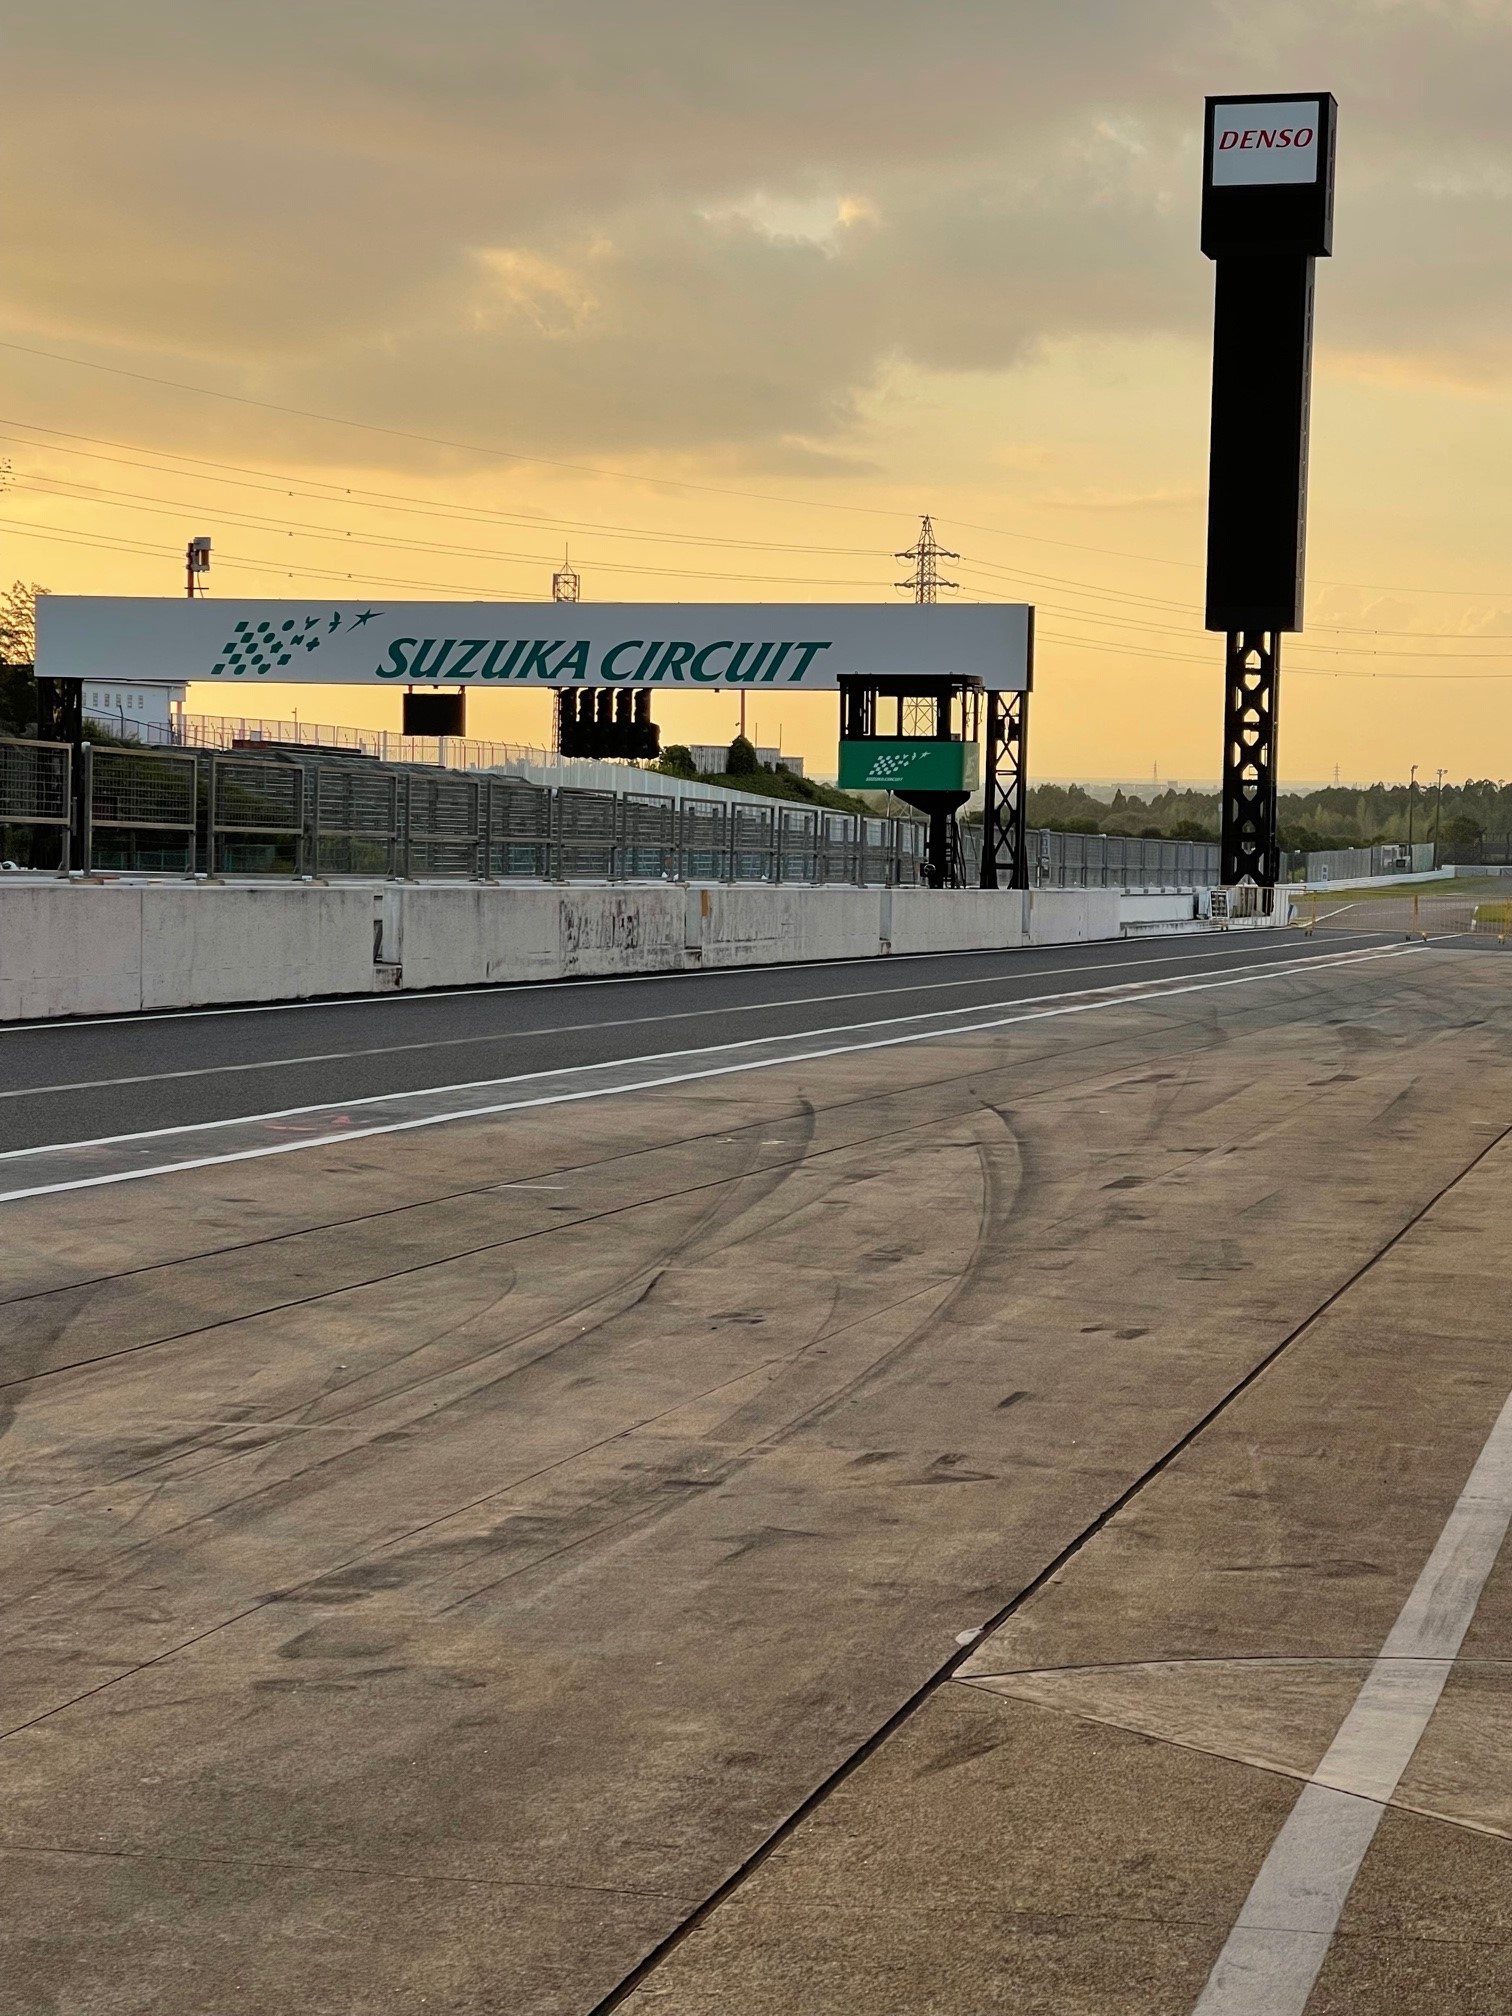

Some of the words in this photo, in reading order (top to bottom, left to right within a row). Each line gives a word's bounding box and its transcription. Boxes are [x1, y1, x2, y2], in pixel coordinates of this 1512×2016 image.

[1218, 128, 1314, 150] DENSO
[376, 638, 591, 680] SUZUKA
[600, 640, 833, 683] CIRCUIT
